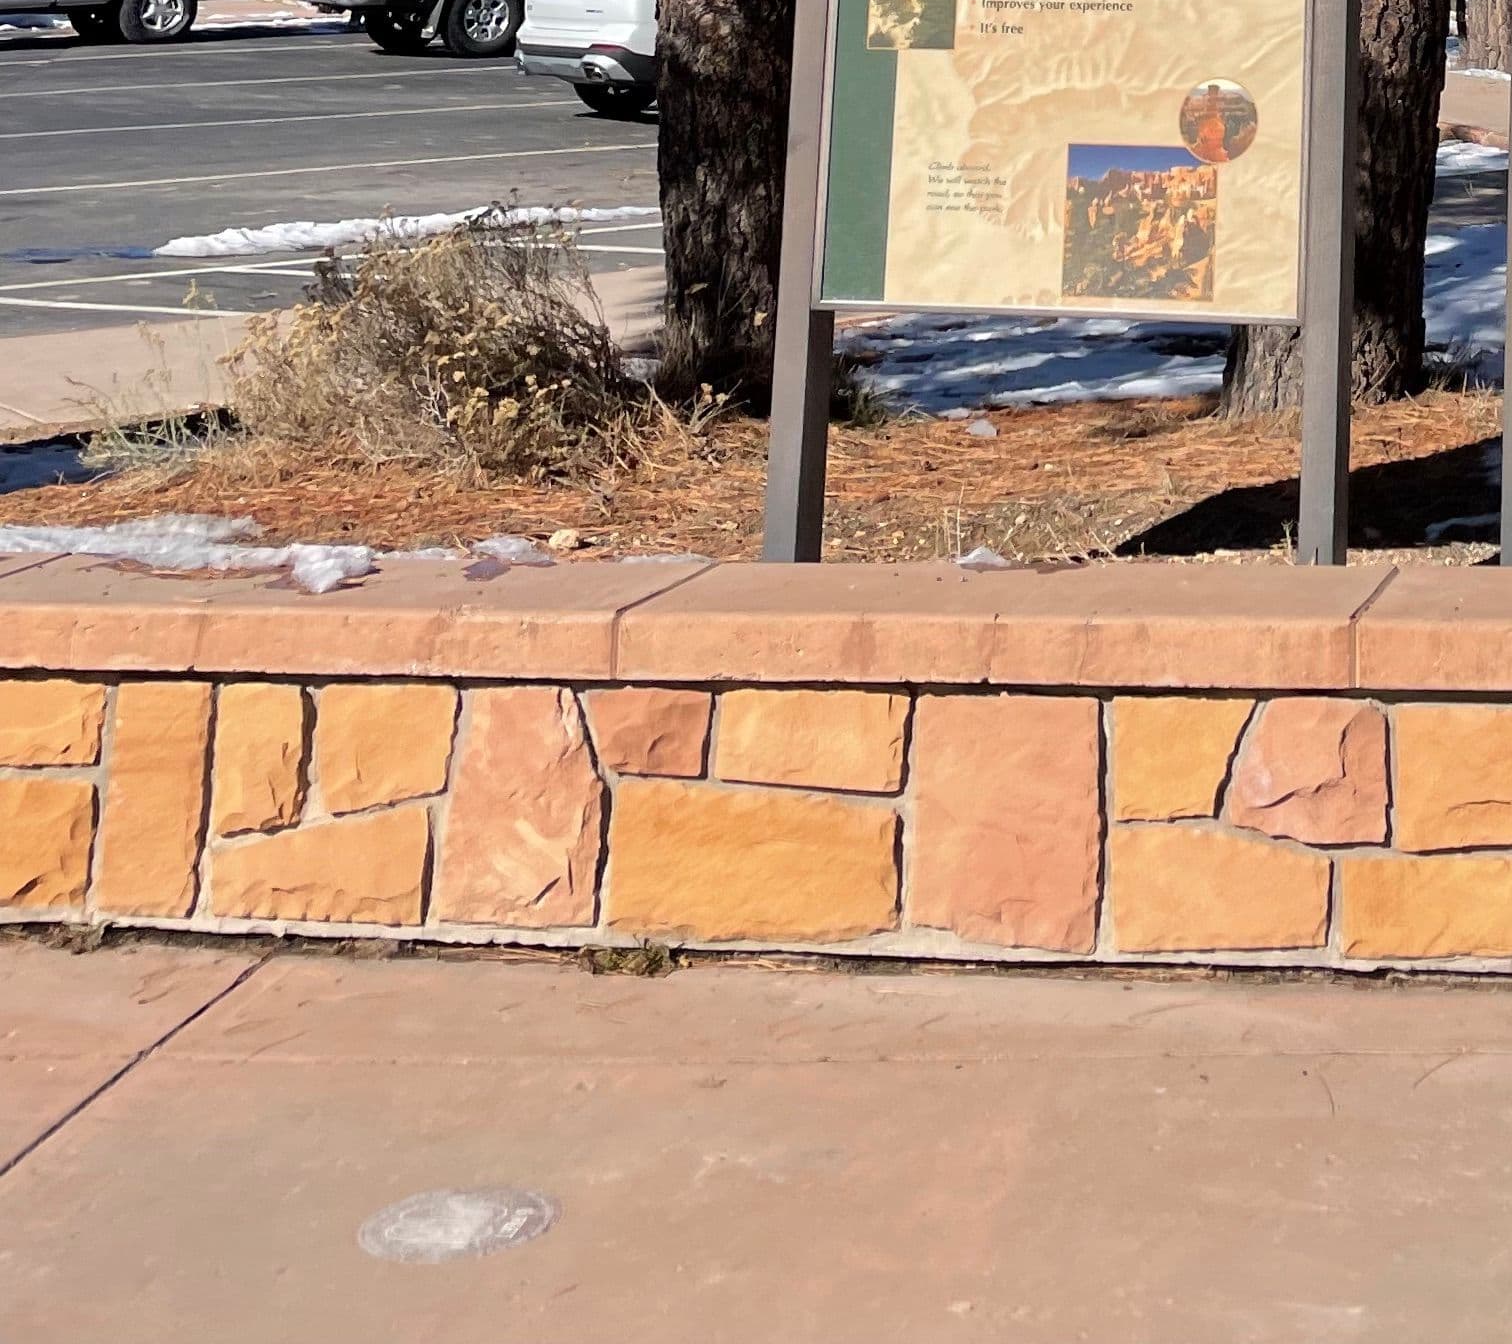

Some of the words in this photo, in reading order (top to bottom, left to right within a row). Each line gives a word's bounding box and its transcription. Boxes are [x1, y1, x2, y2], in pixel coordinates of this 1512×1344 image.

[1039, 0, 1064, 12] your
[1070, 0, 1133, 13] experience
[981, 23, 997, 33] It's
[1001, 22, 1023, 34] free
